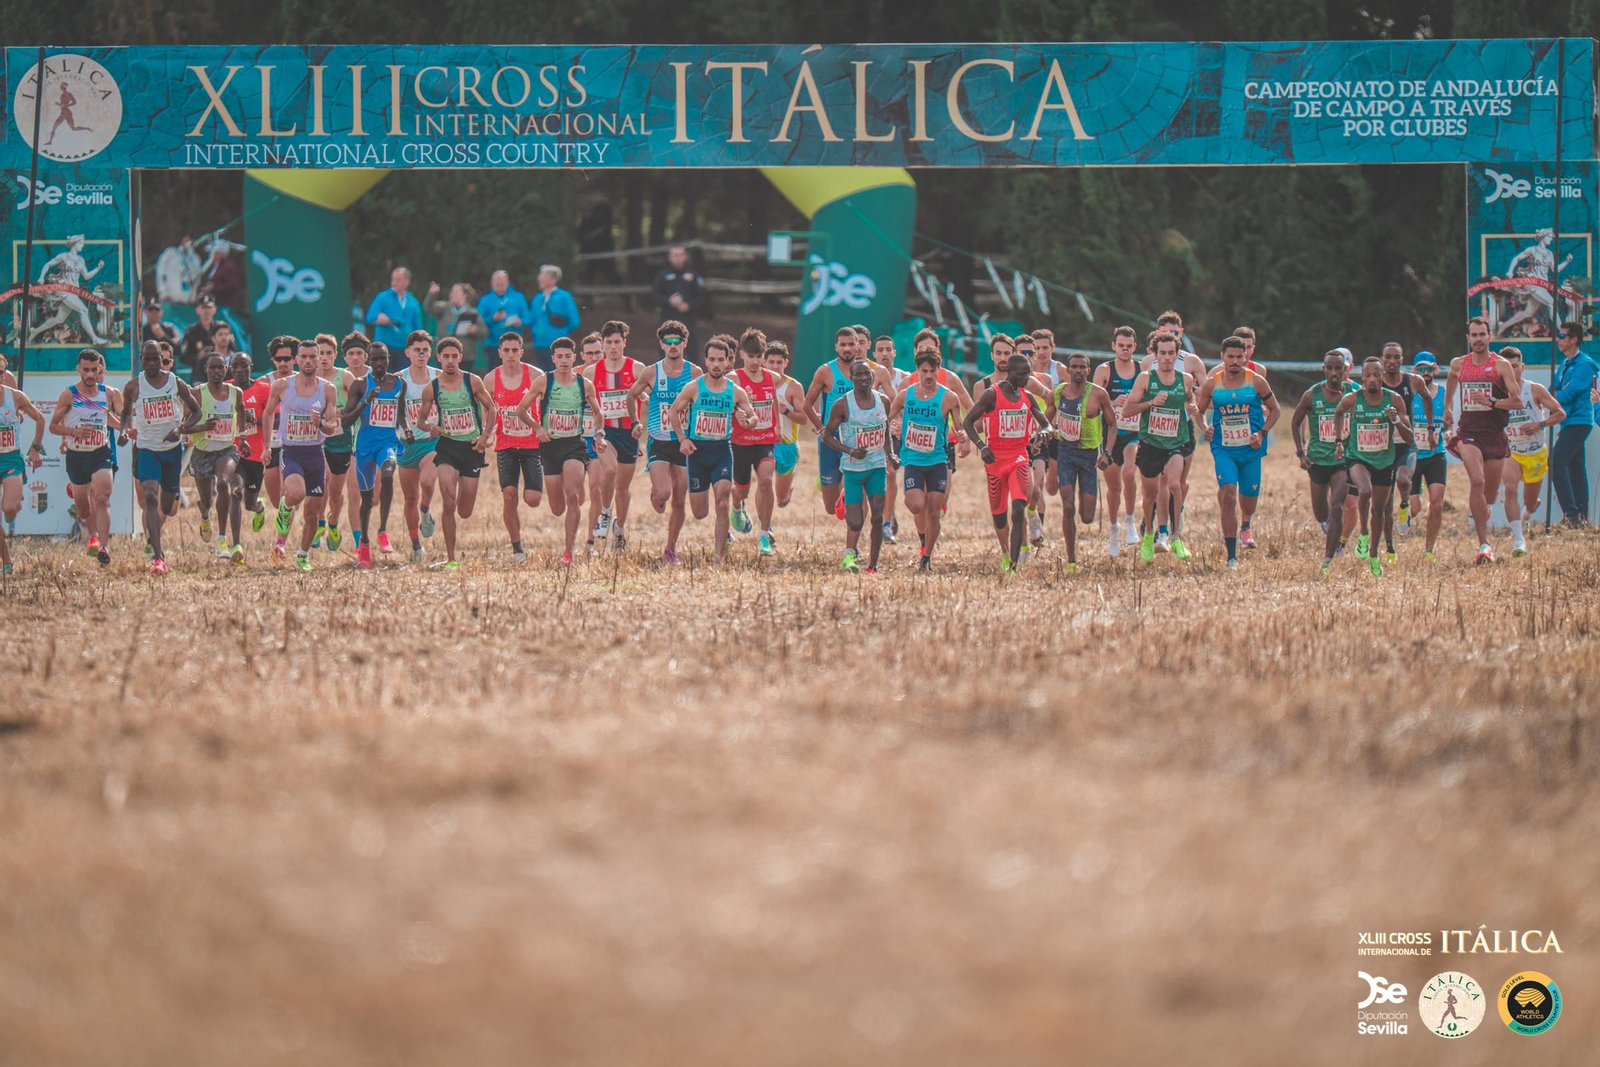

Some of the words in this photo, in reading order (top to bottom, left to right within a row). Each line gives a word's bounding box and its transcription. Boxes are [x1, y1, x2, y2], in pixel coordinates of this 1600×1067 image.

[414, 65, 587, 107] CROSS
[669, 44, 1095, 143] ITÁLICA
[1244, 80, 1395, 99] CAMPEONATO
[1399, 80, 1426, 98] DE
[1430, 76, 1559, 97] ANDALUCÍA
[185, 65, 409, 137] XLIII
[1294, 101, 1322, 118] DE
[1325, 100, 1405, 118] CAMPO
[1409, 100, 1426, 117] A
[1430, 96, 1512, 117] TRAVÉS
[415, 113, 652, 136] INTERNACIONAL
[1343, 120, 1387, 137] POR
[1390, 119, 1468, 136] CLUBES
[185, 144, 395, 164] INTERNATIONAL
[402, 143, 479, 164] CROSS
[486, 143, 609, 164] COUNTRY
[66, 181, 113, 193] Diputación
[66, 193, 113, 206] Sevilla
[603, 401, 627, 411] 5128
[700, 397, 731, 409] nerja
[907, 405, 936, 417] nerja
[1219, 405, 1249, 414] UCAM
[371, 404, 396, 422] KIBET
[856, 430, 884, 449] KOECH
[906, 430, 934, 448] ANGEL
[1223, 429, 1249, 439] 5118
